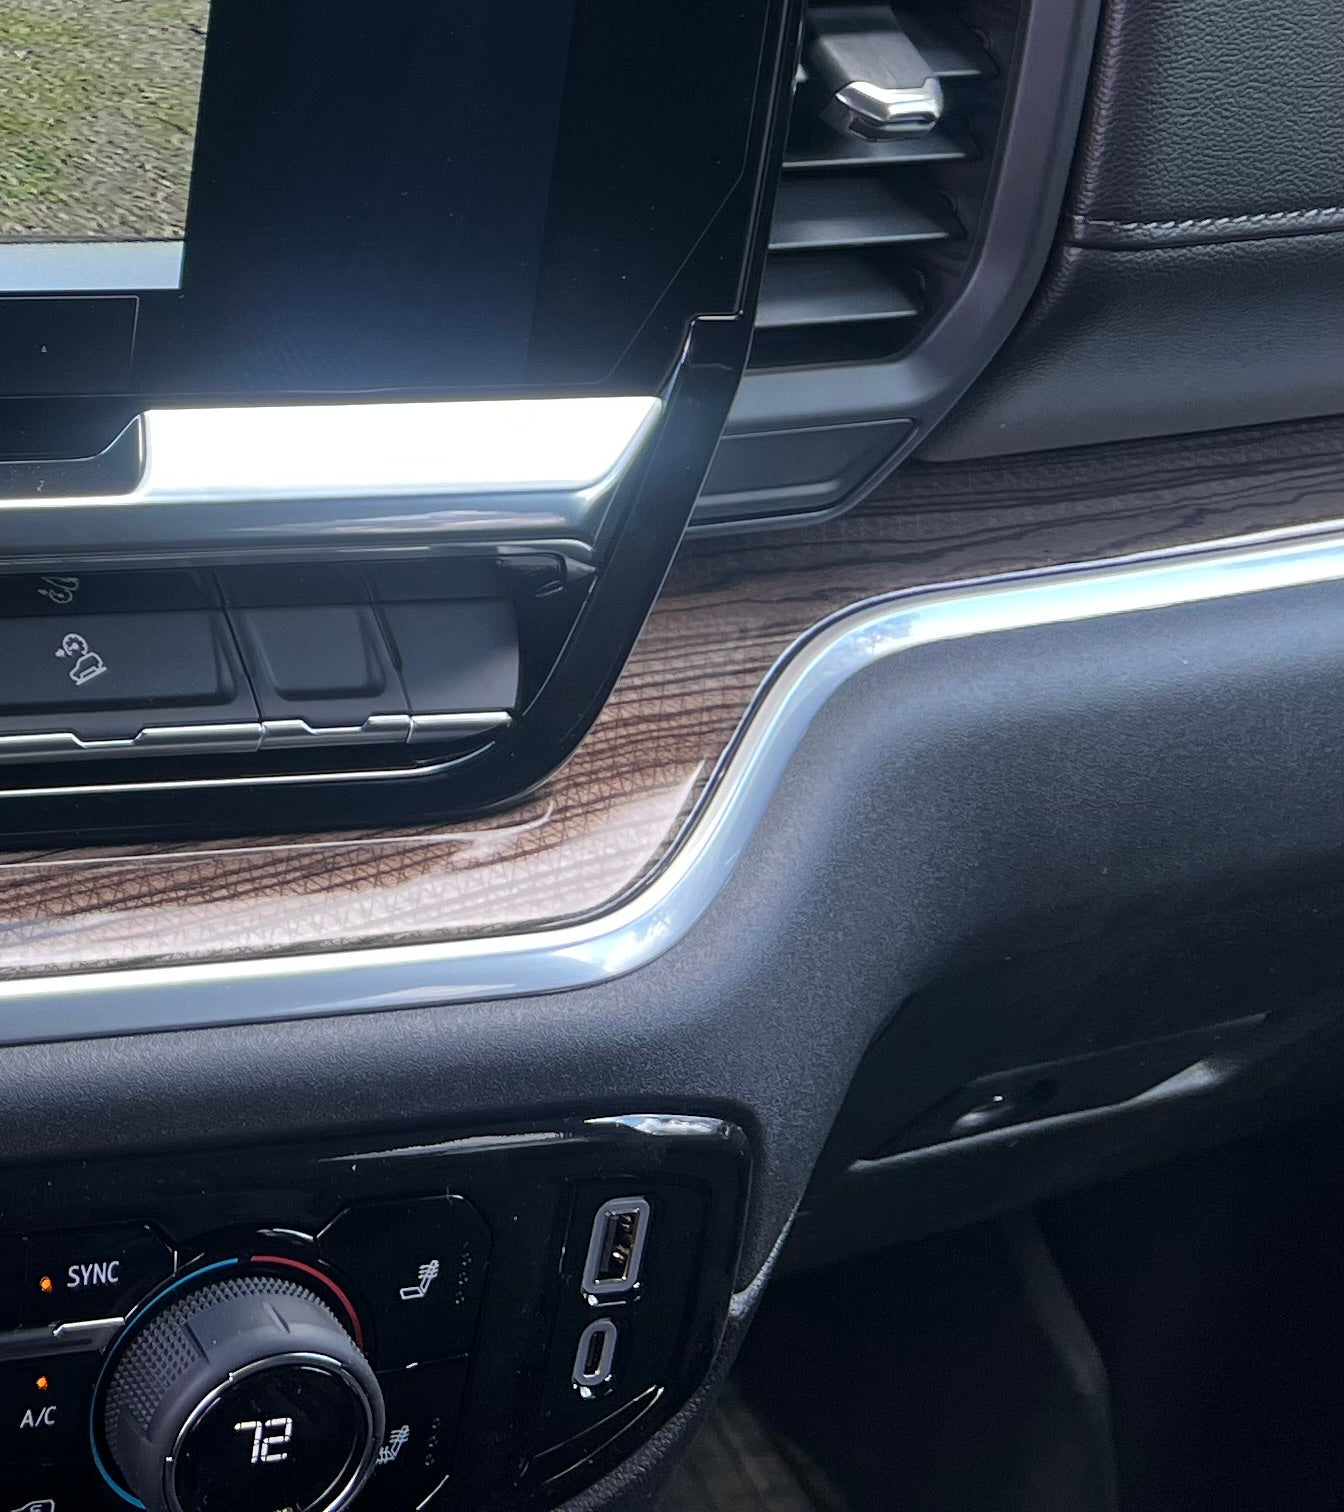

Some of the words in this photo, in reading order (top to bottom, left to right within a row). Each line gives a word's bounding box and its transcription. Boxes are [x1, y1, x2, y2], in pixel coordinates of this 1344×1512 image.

[66, 1260, 120, 1288] SYNC
[19, 1405, 57, 1429] A/C
[233, 1417, 293, 1464] 72
